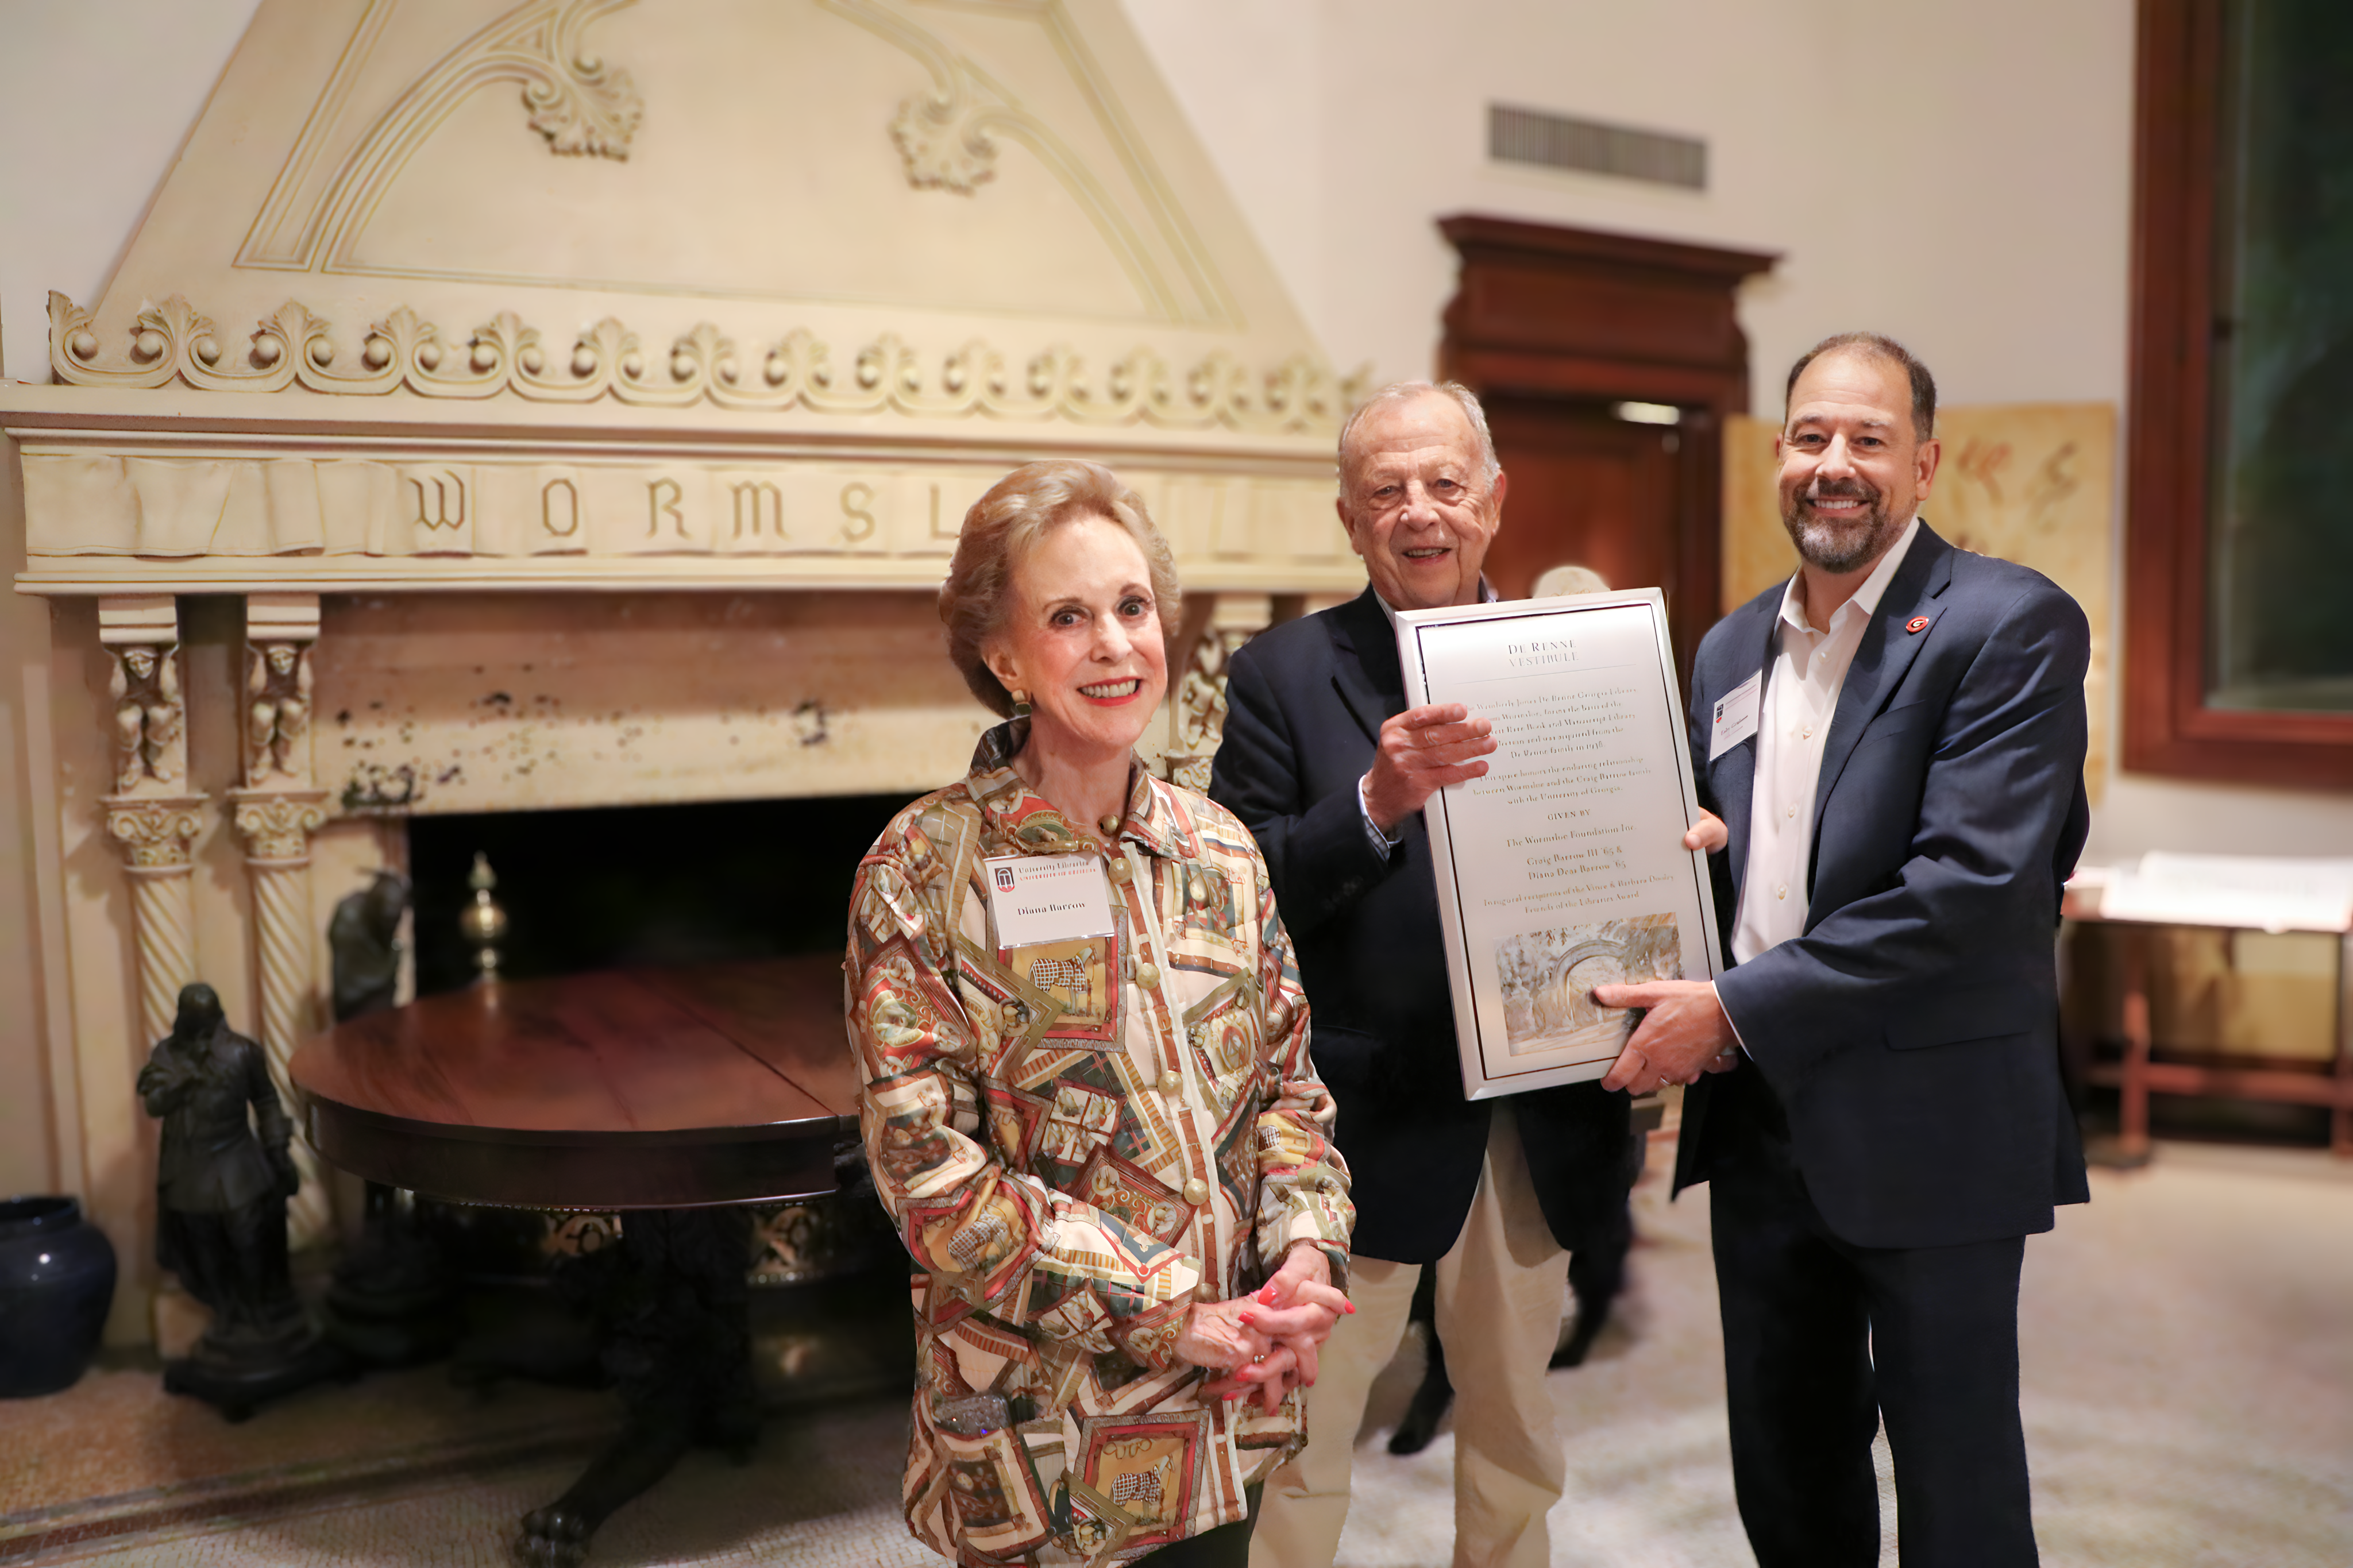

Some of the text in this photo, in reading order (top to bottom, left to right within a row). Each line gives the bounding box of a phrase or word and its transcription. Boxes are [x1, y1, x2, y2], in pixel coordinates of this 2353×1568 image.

[406, 468, 960, 544] WORMSL
[1508, 640, 1576, 654] DE RENNE
[1509, 652, 1579, 666] VESTIBULE
[1548, 811, 1576, 820] GIVEN
[1505, 839, 1523, 847] The
[1570, 828, 1618, 838] Foundation
[1526, 857, 1551, 866] Craig
[1587, 849, 1598, 857] III
[1528, 872, 1554, 880] Diana
[1017, 902, 1085, 916] Diana Barrow
